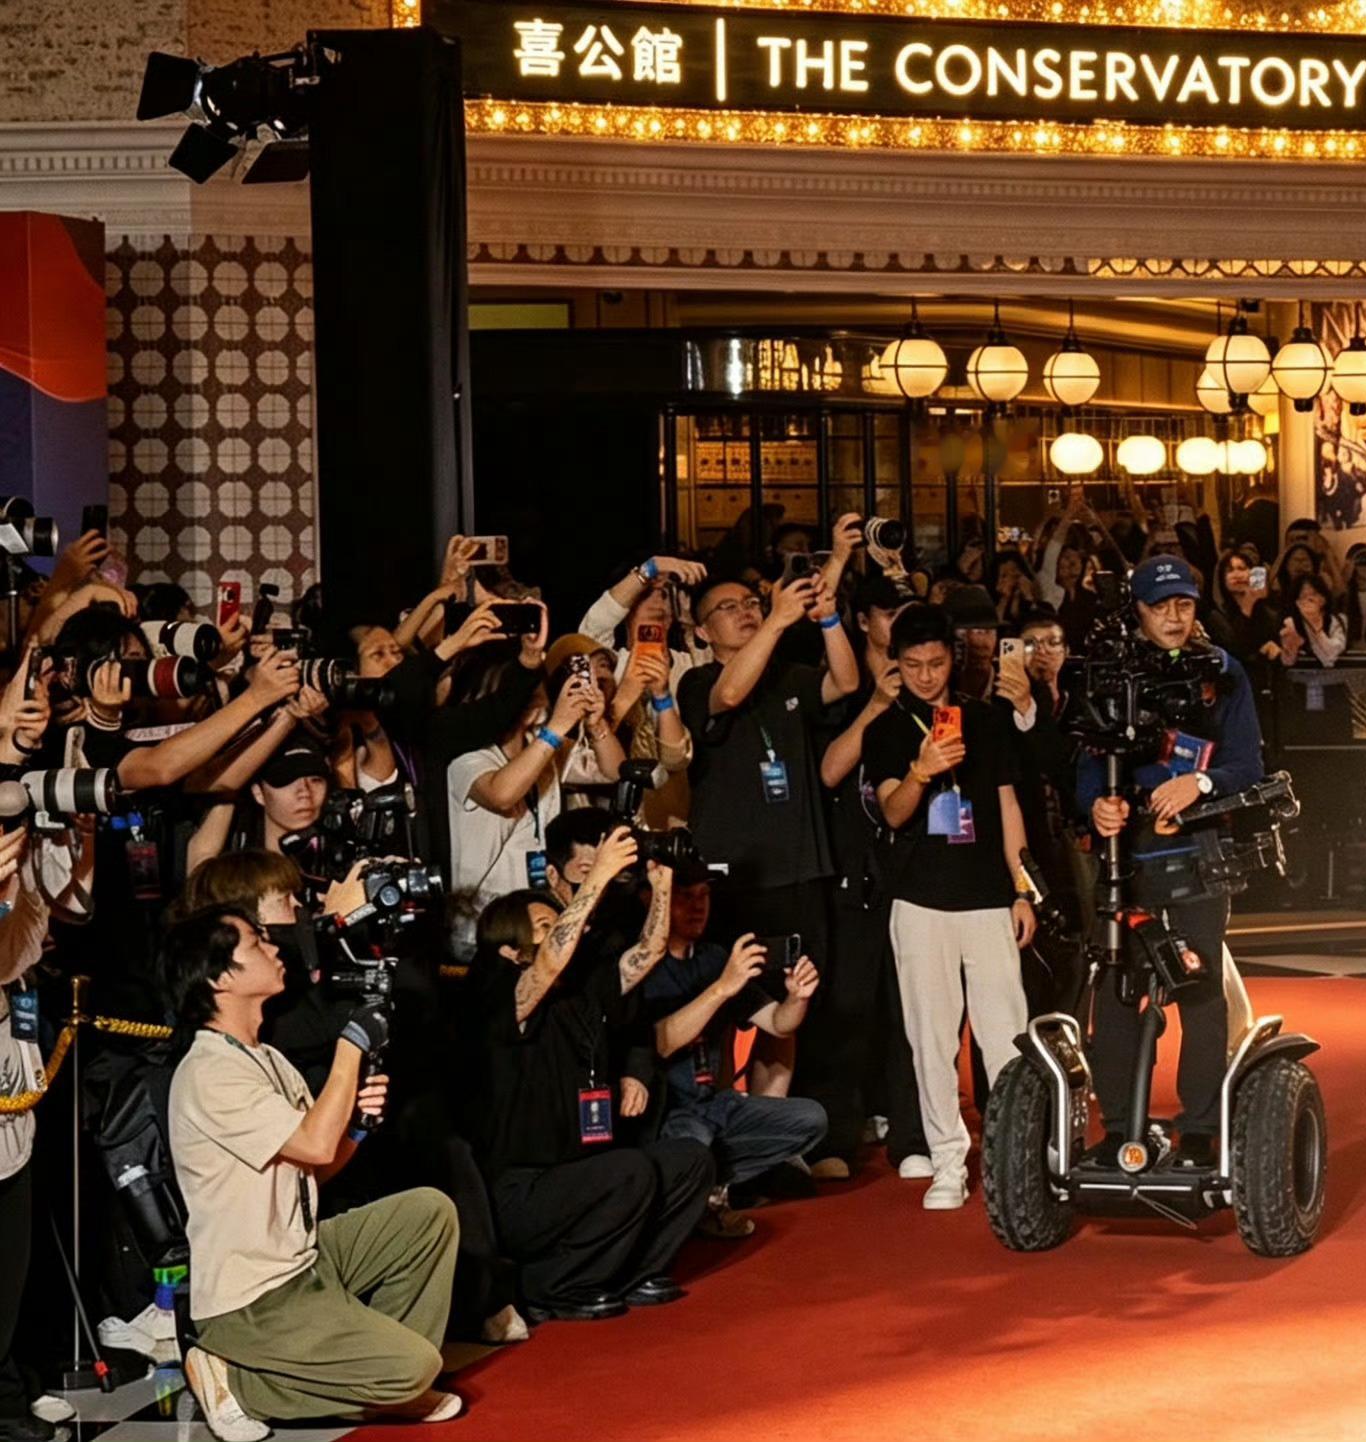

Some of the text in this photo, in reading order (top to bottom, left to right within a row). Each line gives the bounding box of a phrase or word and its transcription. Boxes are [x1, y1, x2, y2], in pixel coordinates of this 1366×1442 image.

[513, 18, 683, 84] 喜公館
[757, 37, 869, 92] THE
